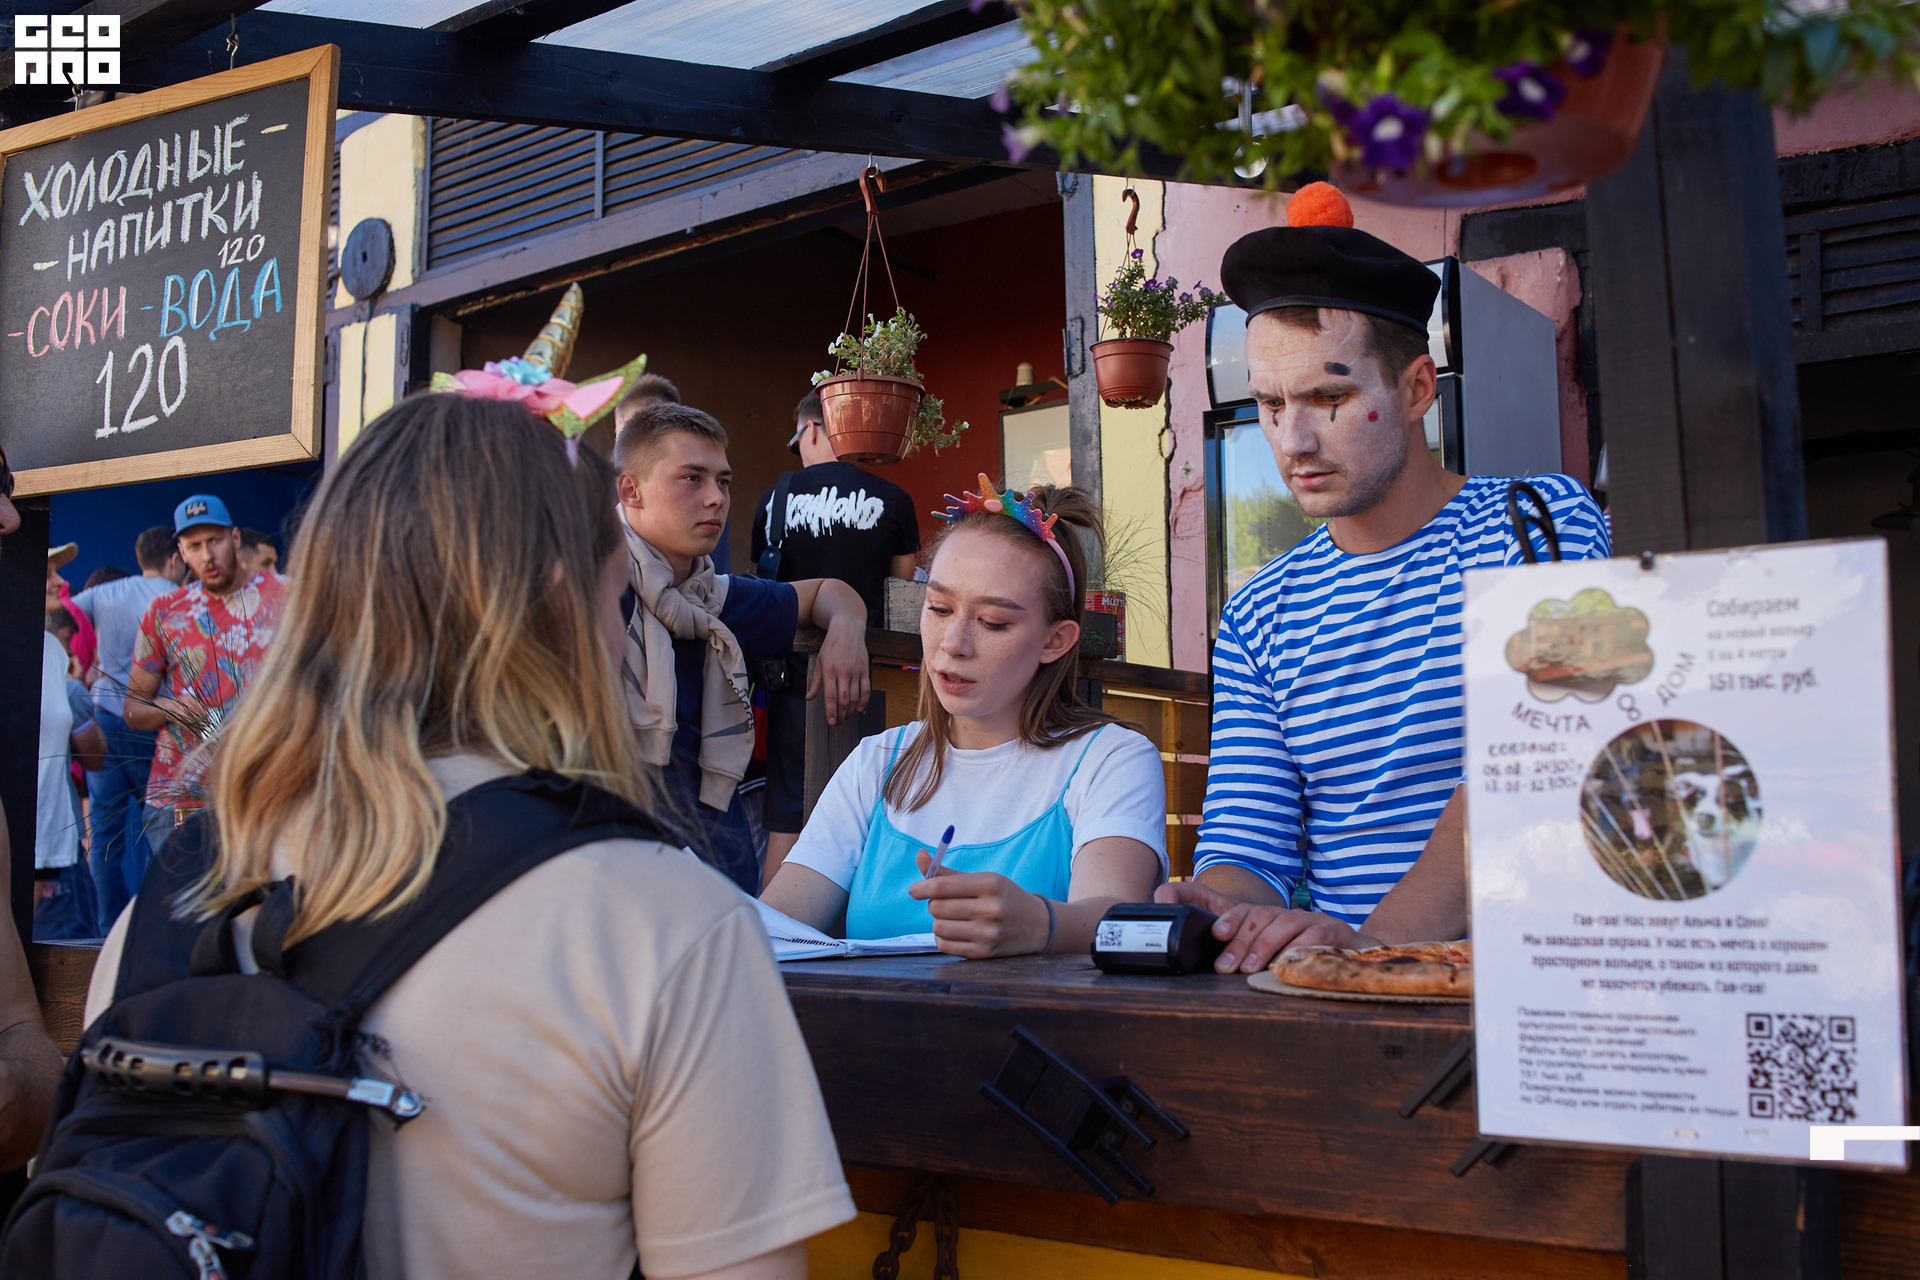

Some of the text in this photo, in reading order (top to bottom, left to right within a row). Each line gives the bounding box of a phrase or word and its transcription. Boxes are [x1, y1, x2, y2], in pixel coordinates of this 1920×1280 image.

[19, 114, 249, 226] ХОЛОДНЫЕ
[217, 233, 265, 269] 120
[95, 335, 188, 439] 120
[1707, 598, 1799, 620] Собираем
[1726, 626, 1765, 640] новый
[1708, 673, 1734, 691] 151
[1782, 667, 1820, 693] руб.
[1511, 701, 1592, 733] МЕЧТА
[1624, 914, 1645, 927] Нас
[1648, 916, 1680, 930] зовут
[1683, 915, 1721, 928] Альма
[1522, 934, 1542, 946] Мы
[1544, 936, 1604, 948] заводская
[1656, 937, 1663, 948] У
[1666, 939, 1687, 950] нас
[1690, 939, 1716, 950] есть
[1720, 940, 1756, 951] мечта
[1770, 940, 1828, 954] хорошем
[1532, 955, 1600, 970] просторном
[1669, 959, 1705, 971] таком
[1727, 960, 1781, 976] которого
[1785, 962, 1819, 975] даже
[1581, 978, 1596, 989] не
[1599, 979, 1656, 991] захочется
